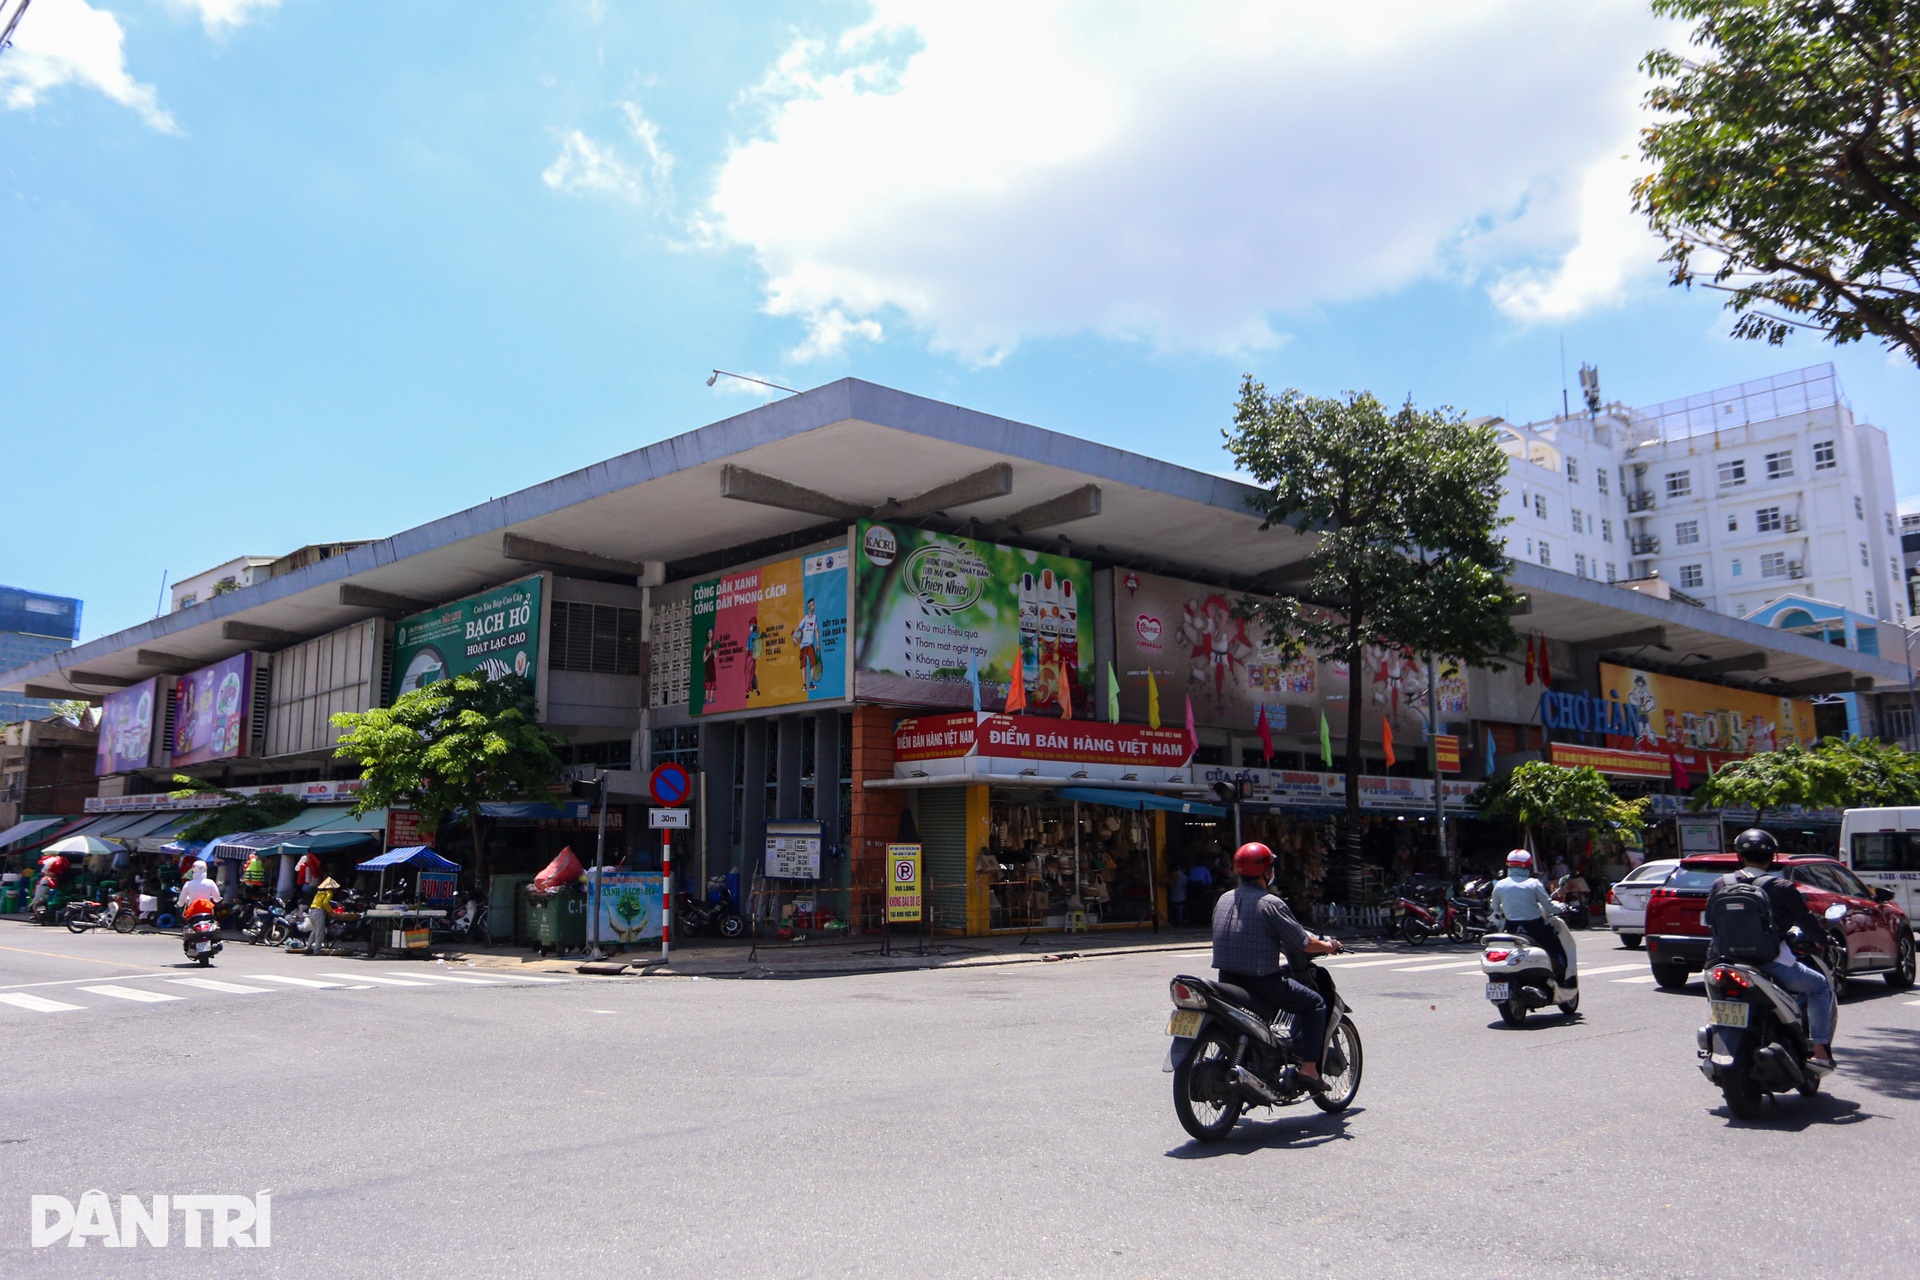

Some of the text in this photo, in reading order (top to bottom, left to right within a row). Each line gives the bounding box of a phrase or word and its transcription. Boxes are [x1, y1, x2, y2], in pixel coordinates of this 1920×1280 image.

[866, 537, 894, 551] KAORI
[694, 576, 757, 600] CÔNG DÂN XANH
[694, 583, 787, 615] CÔNG DÂN PHONG CÁCH
[466, 611, 505, 640] BẠCH
[509, 593, 531, 628] HỔ
[474, 605, 482, 614] Cao
[484, 602, 492, 611] Xoa
[503, 596, 512, 606] Cao
[467, 632, 526, 655] HOẠT LẠC CAO
[1542, 689, 1640, 742] CHỢ HÀN
[897, 729, 974, 749] ĐIỂM BÁN HÀNG VIỆT NAM
[989, 726, 1183, 756] ĐIỂM BÁN HÀNG VIỆT NAM
[1205, 767, 1230, 782] CỬA
[1253, 774, 1260, 783] 2
[422, 875, 440, 899] BÚN
[602, 888, 620, 897] XANH
[624, 887, 640, 896] SẠCH
[1715, 1002, 1742, 1014] 43-C1
